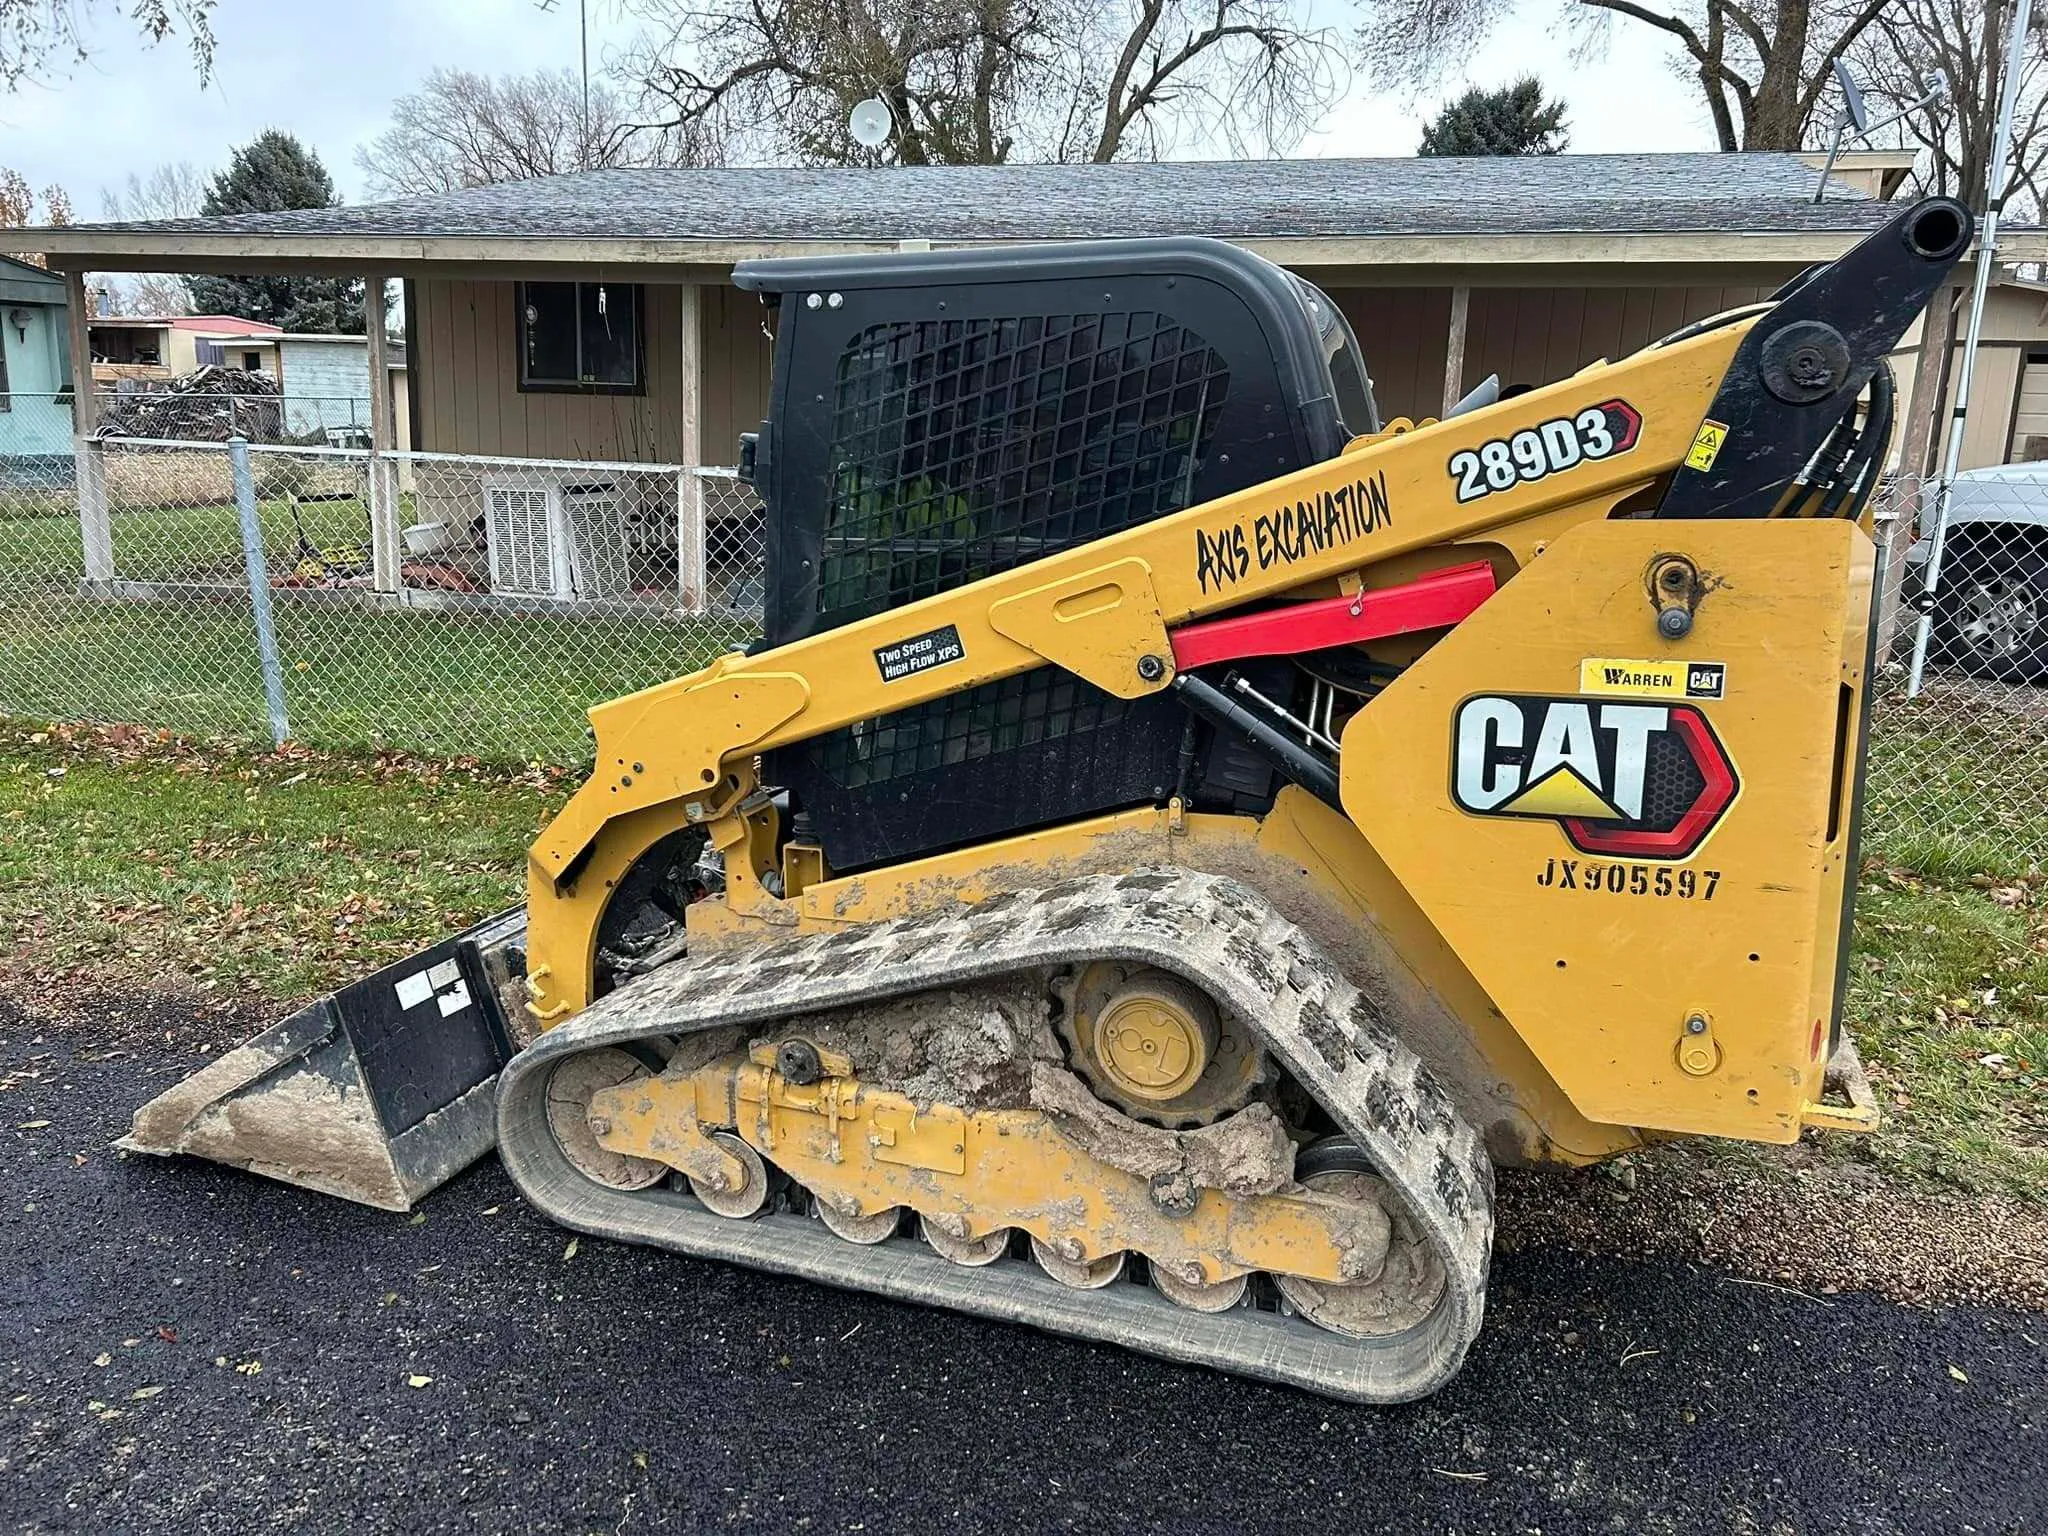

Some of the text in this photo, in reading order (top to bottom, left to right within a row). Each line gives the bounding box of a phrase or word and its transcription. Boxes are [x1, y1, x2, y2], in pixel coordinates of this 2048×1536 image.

[1450, 408, 1614, 501] 289D3
[1196, 469, 1392, 595] AXIS EXCAVATION
[885, 644, 959, 678] HIGH FLOW XPS
[1604, 668, 1722, 689] WARREN CAT
[1457, 697, 1669, 821] CAT
[1536, 857, 1721, 901] JX905597
